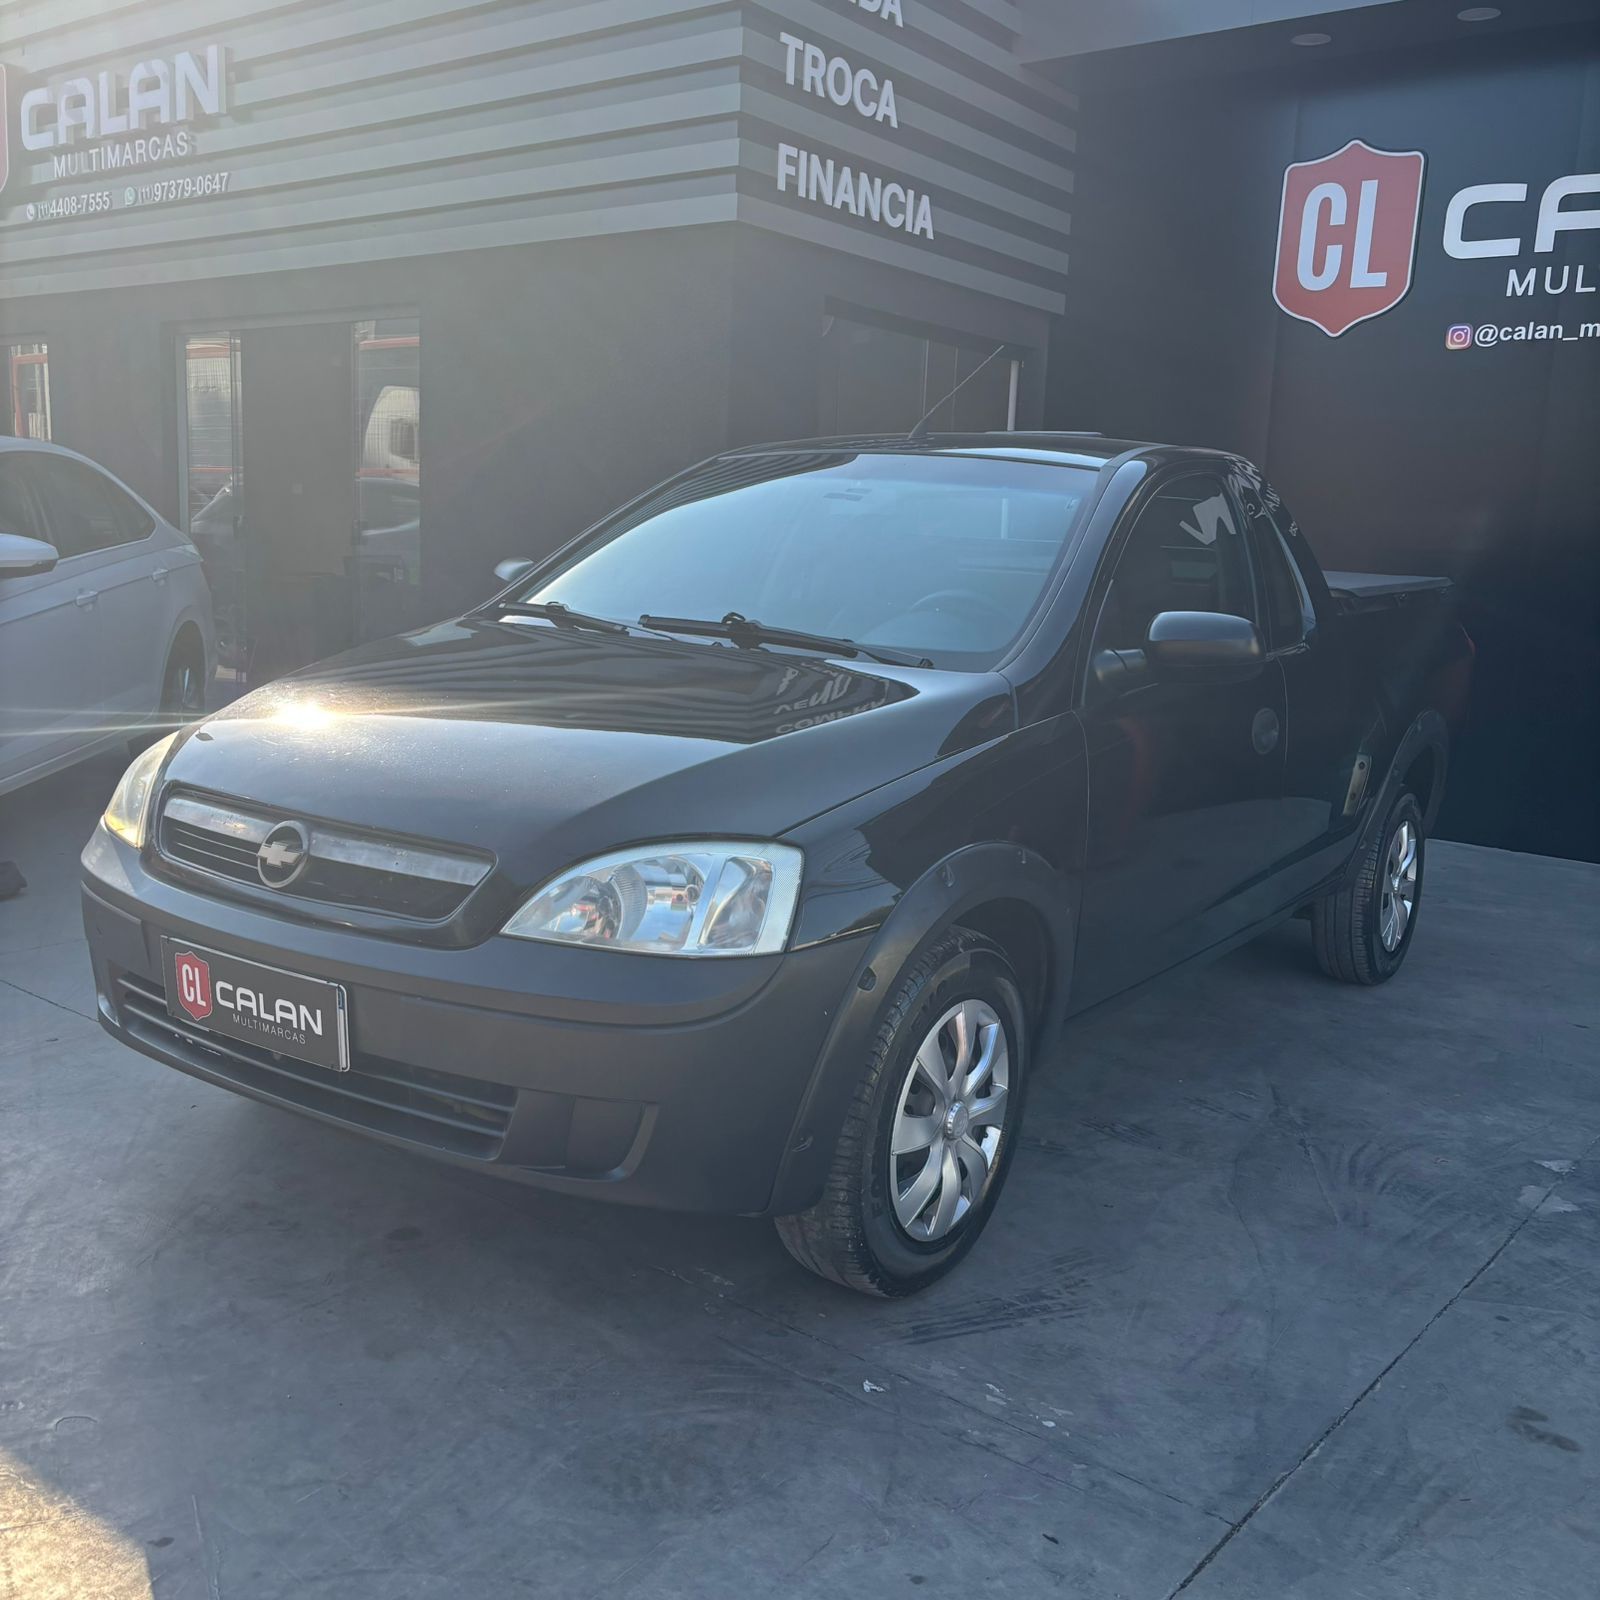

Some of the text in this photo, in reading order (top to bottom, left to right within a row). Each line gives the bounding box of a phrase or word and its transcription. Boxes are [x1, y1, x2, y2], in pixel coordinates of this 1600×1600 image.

[21, 44, 224, 151] CALAN
[780, 32, 898, 128] TROCA
[53, 131, 189, 178] MULTIMARCAS
[777, 143, 934, 240] FINANCIA
[1296, 179, 1388, 291] CL
[1505, 264, 1597, 297] MUL
[1474, 321, 1600, 347] @calan_m
[182, 963, 207, 1007] CL
[216, 981, 323, 1036] CALAN
[232, 1013, 306, 1045] MULTIMARCAS
